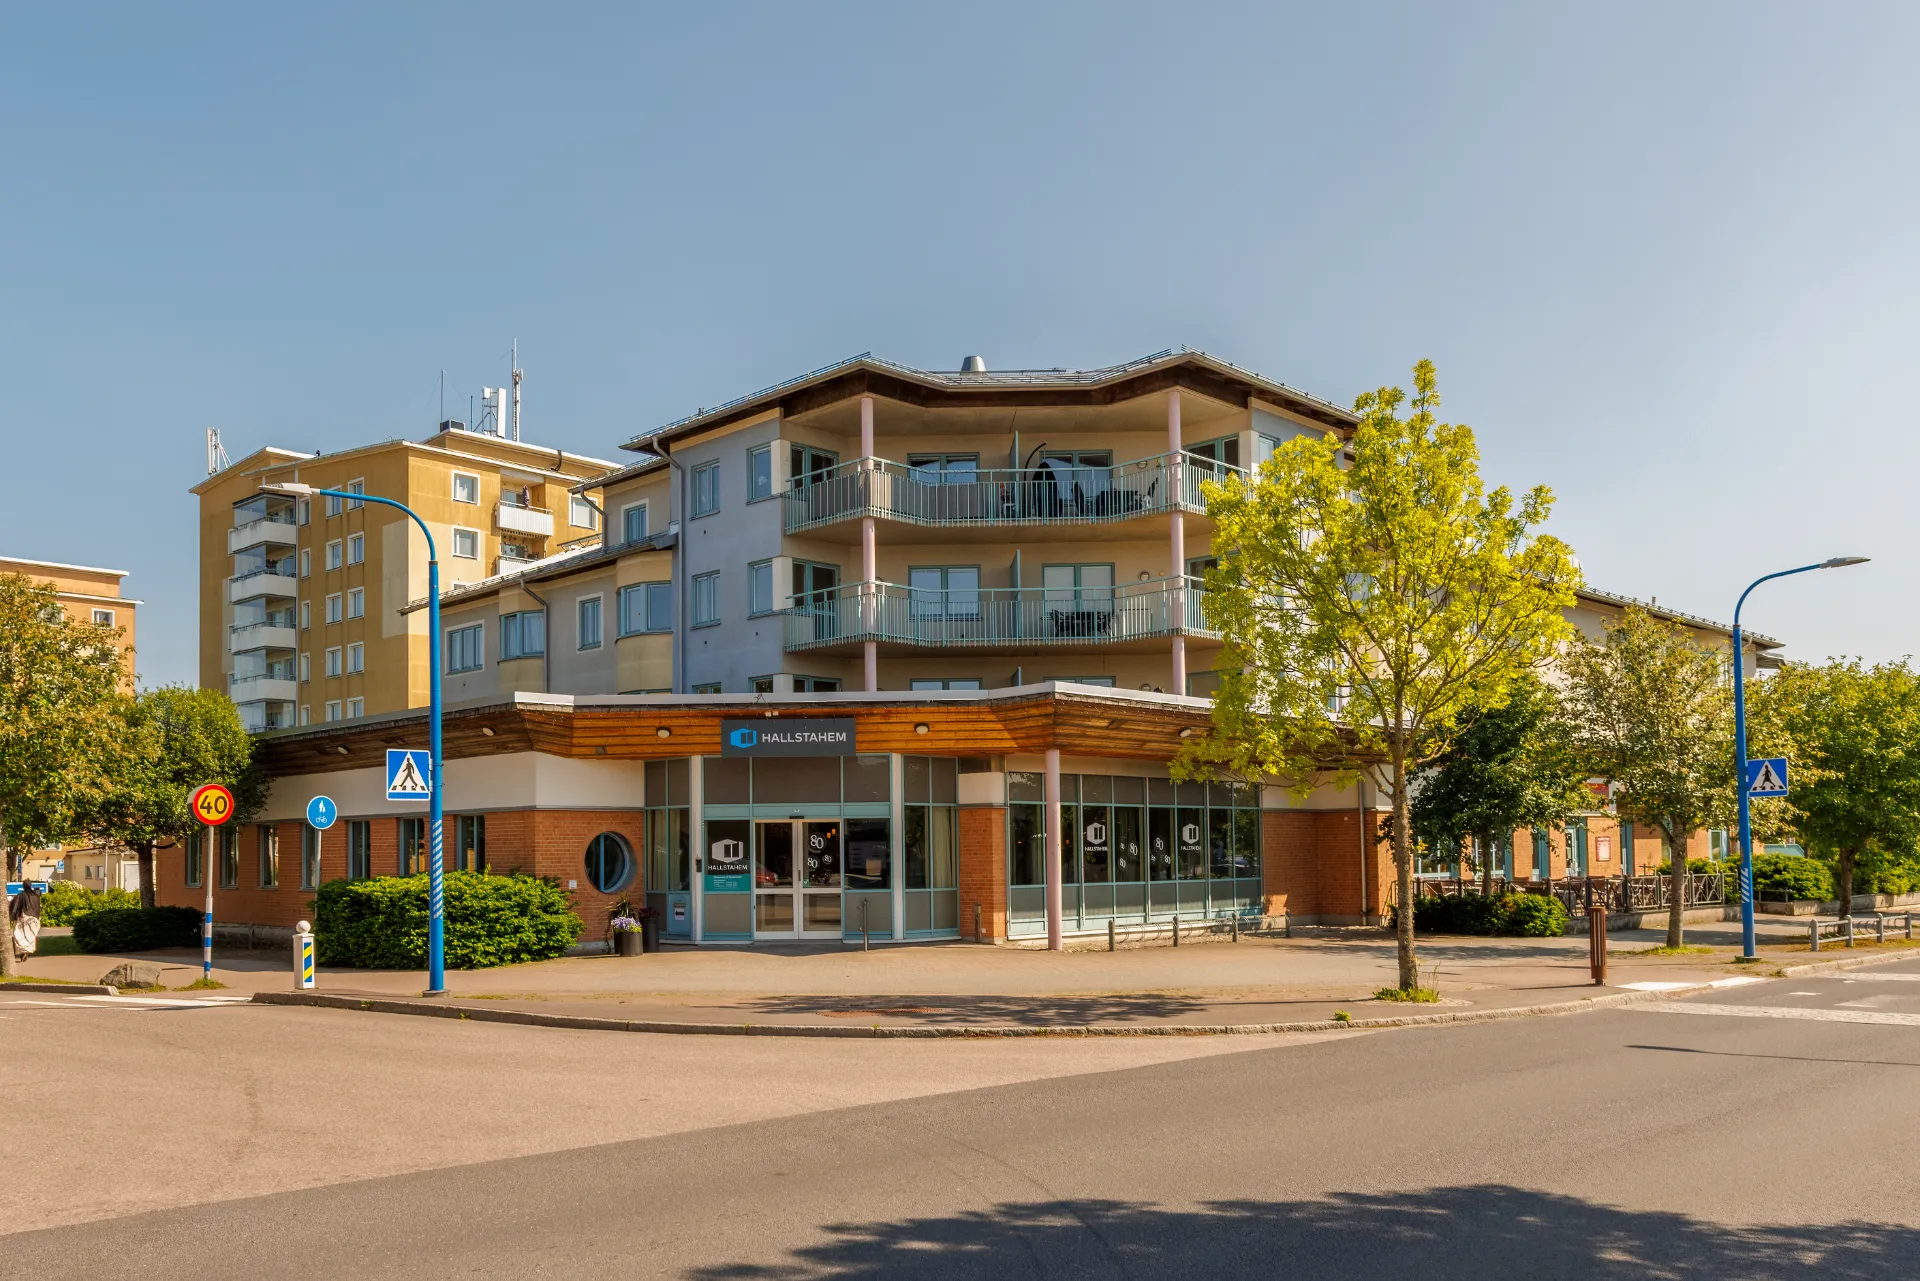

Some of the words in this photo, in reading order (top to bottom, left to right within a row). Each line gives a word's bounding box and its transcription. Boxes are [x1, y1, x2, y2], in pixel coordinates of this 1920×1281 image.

[762, 732, 847, 743] HALLSTAHEM
[200, 795, 227, 814] 40
[810, 834, 824, 849] 80
[1155, 837, 1163, 850] 80
[1129, 842, 1138, 856] 80
[807, 857, 818, 868] 80
[824, 854, 832, 863] 80
